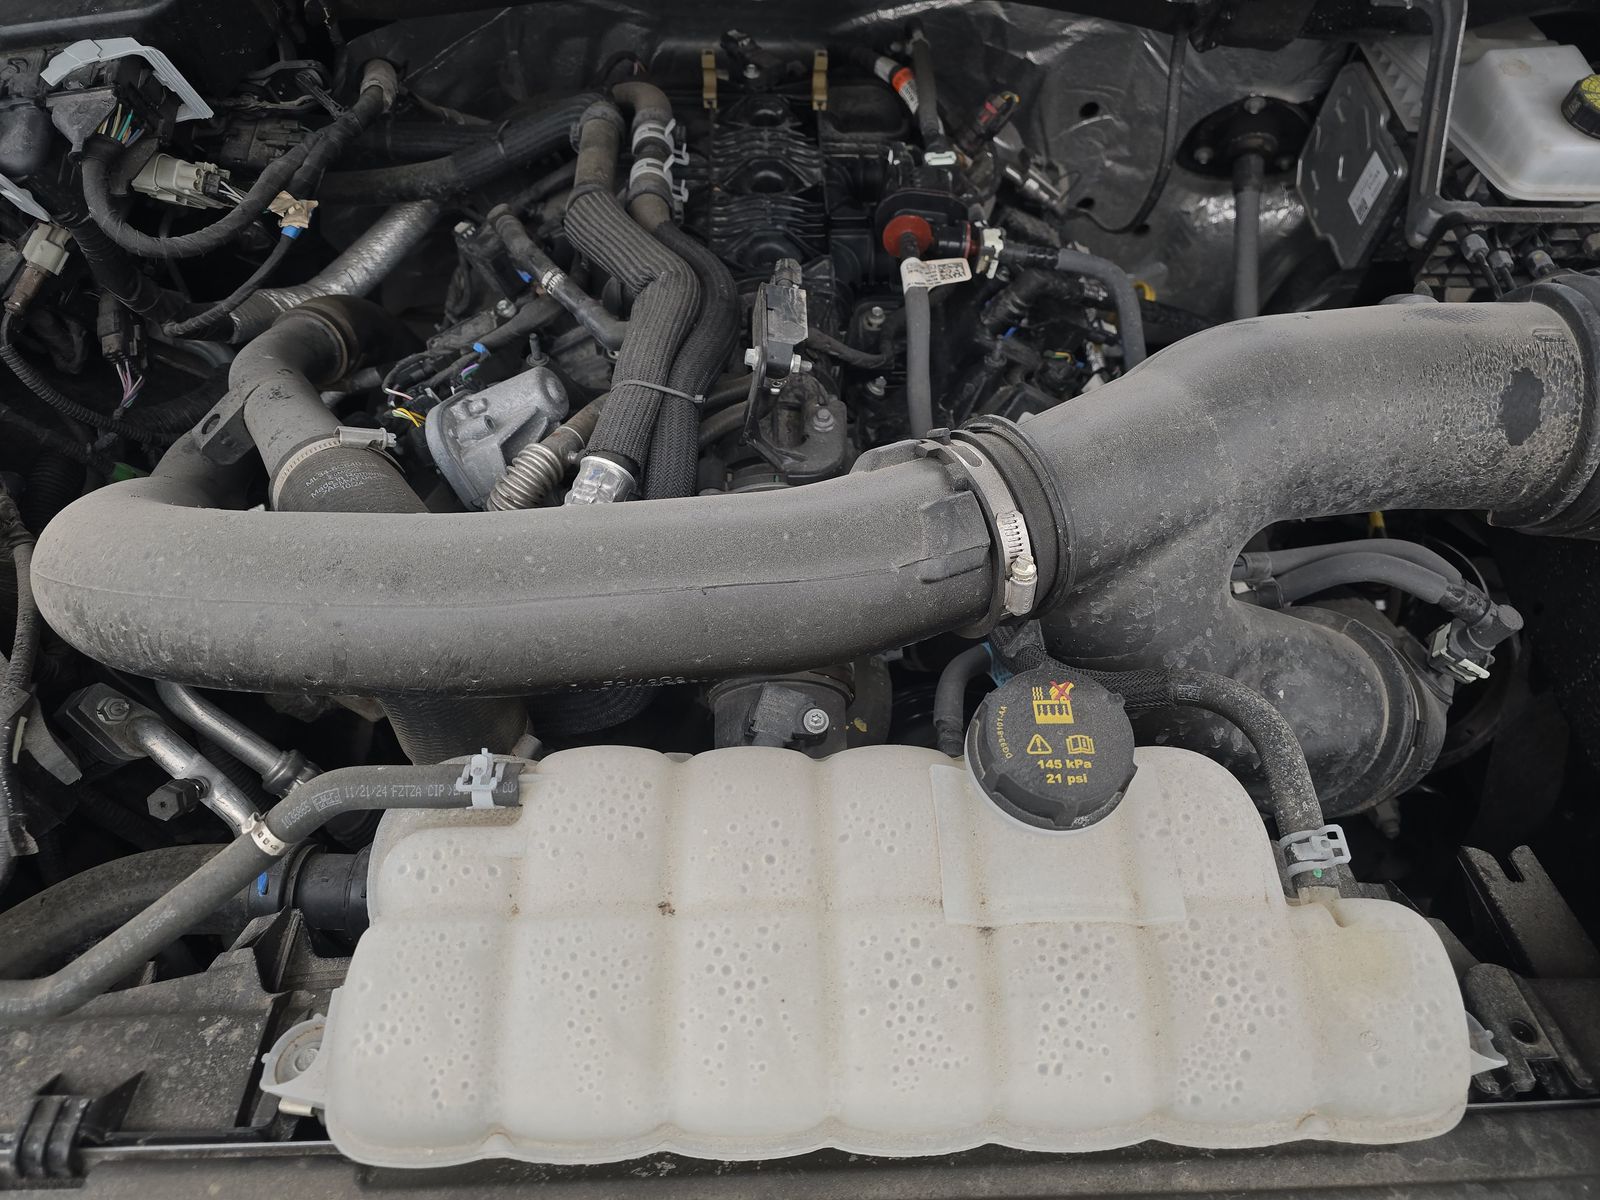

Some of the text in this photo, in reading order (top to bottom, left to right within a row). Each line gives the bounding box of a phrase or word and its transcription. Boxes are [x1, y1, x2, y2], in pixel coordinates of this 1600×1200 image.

[1037, 759, 1092, 769] 145 kPa
[1046, 773, 1088, 785] 21 psi
[344, 784, 387, 798] 11/21/24
